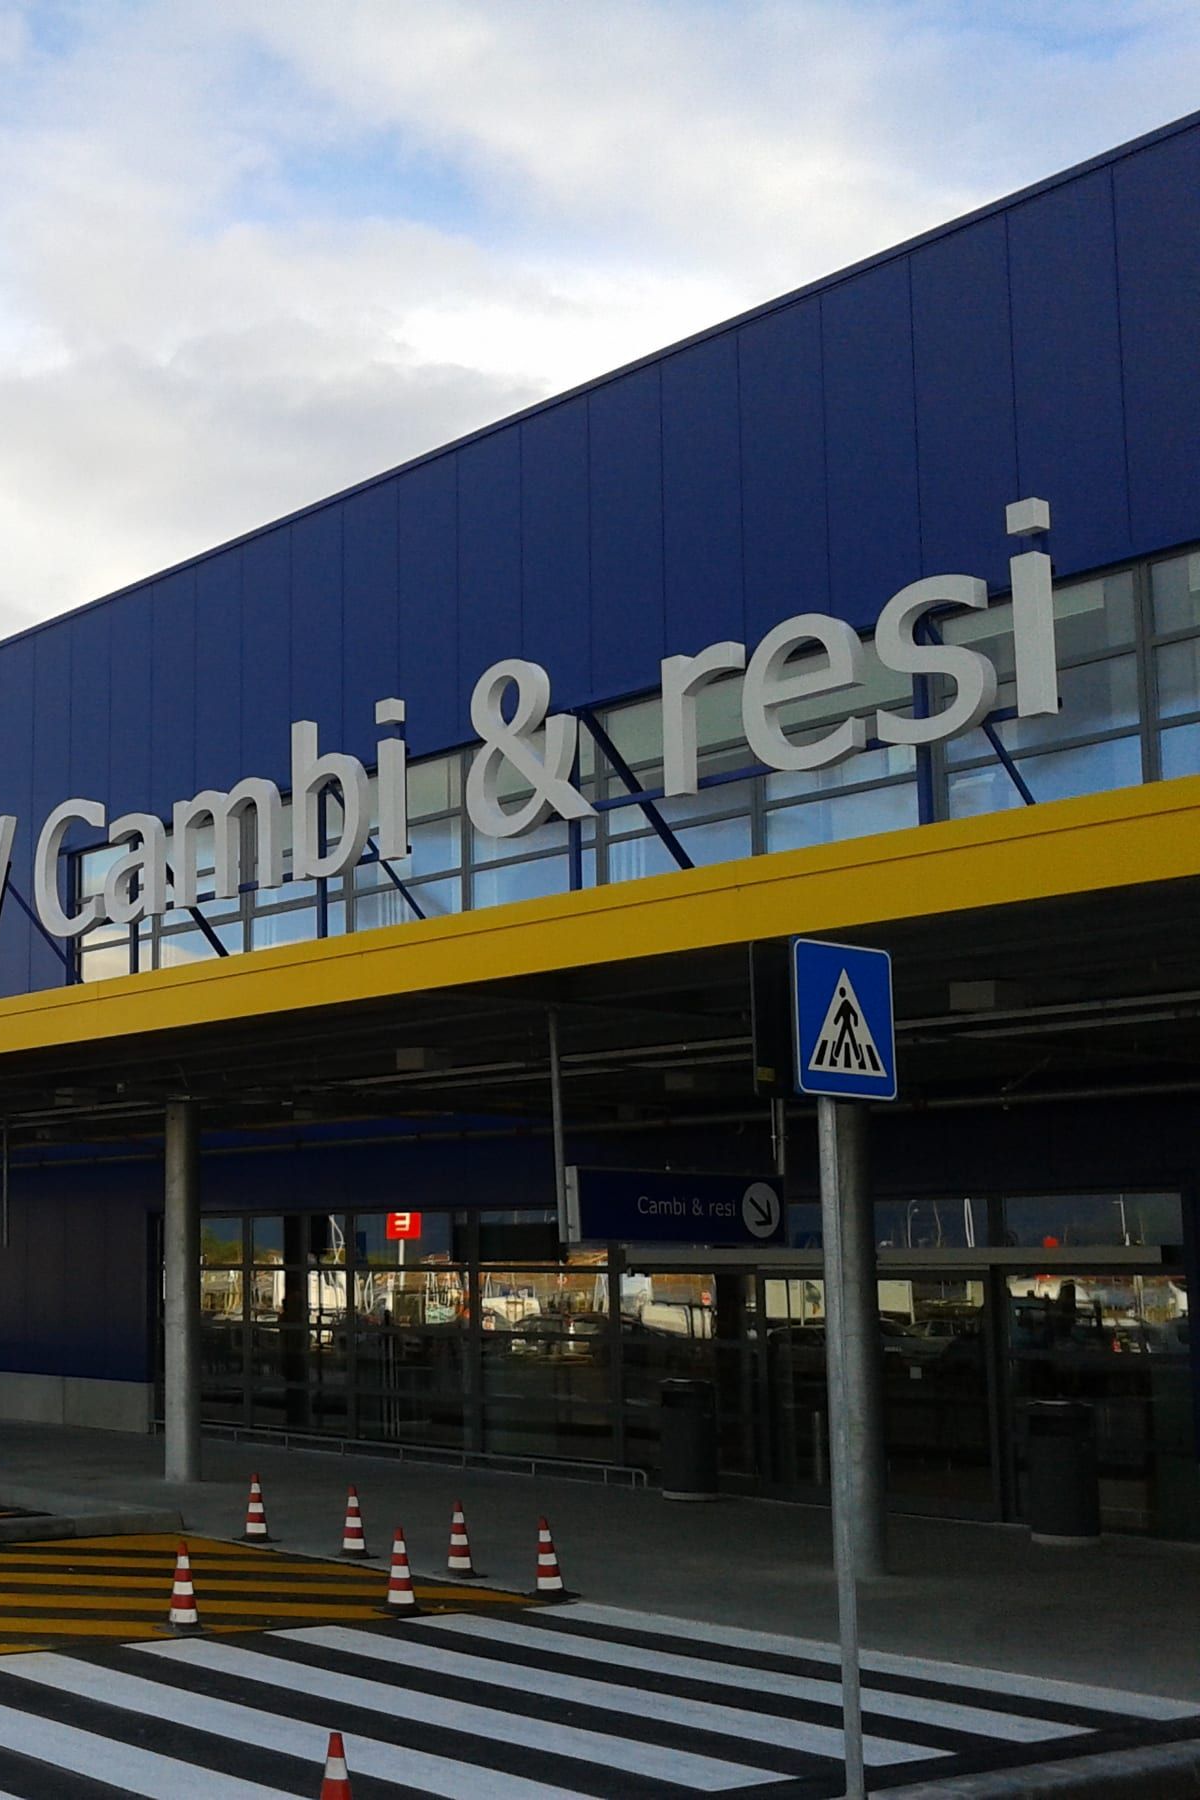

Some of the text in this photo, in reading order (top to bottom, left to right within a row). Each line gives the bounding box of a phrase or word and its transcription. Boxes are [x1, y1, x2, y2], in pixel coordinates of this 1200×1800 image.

[34, 697, 408, 938] Cambi
[466, 658, 599, 838] &
[661, 497, 1059, 797] resi
[637, 1195, 736, 1217] Cambi & resi
